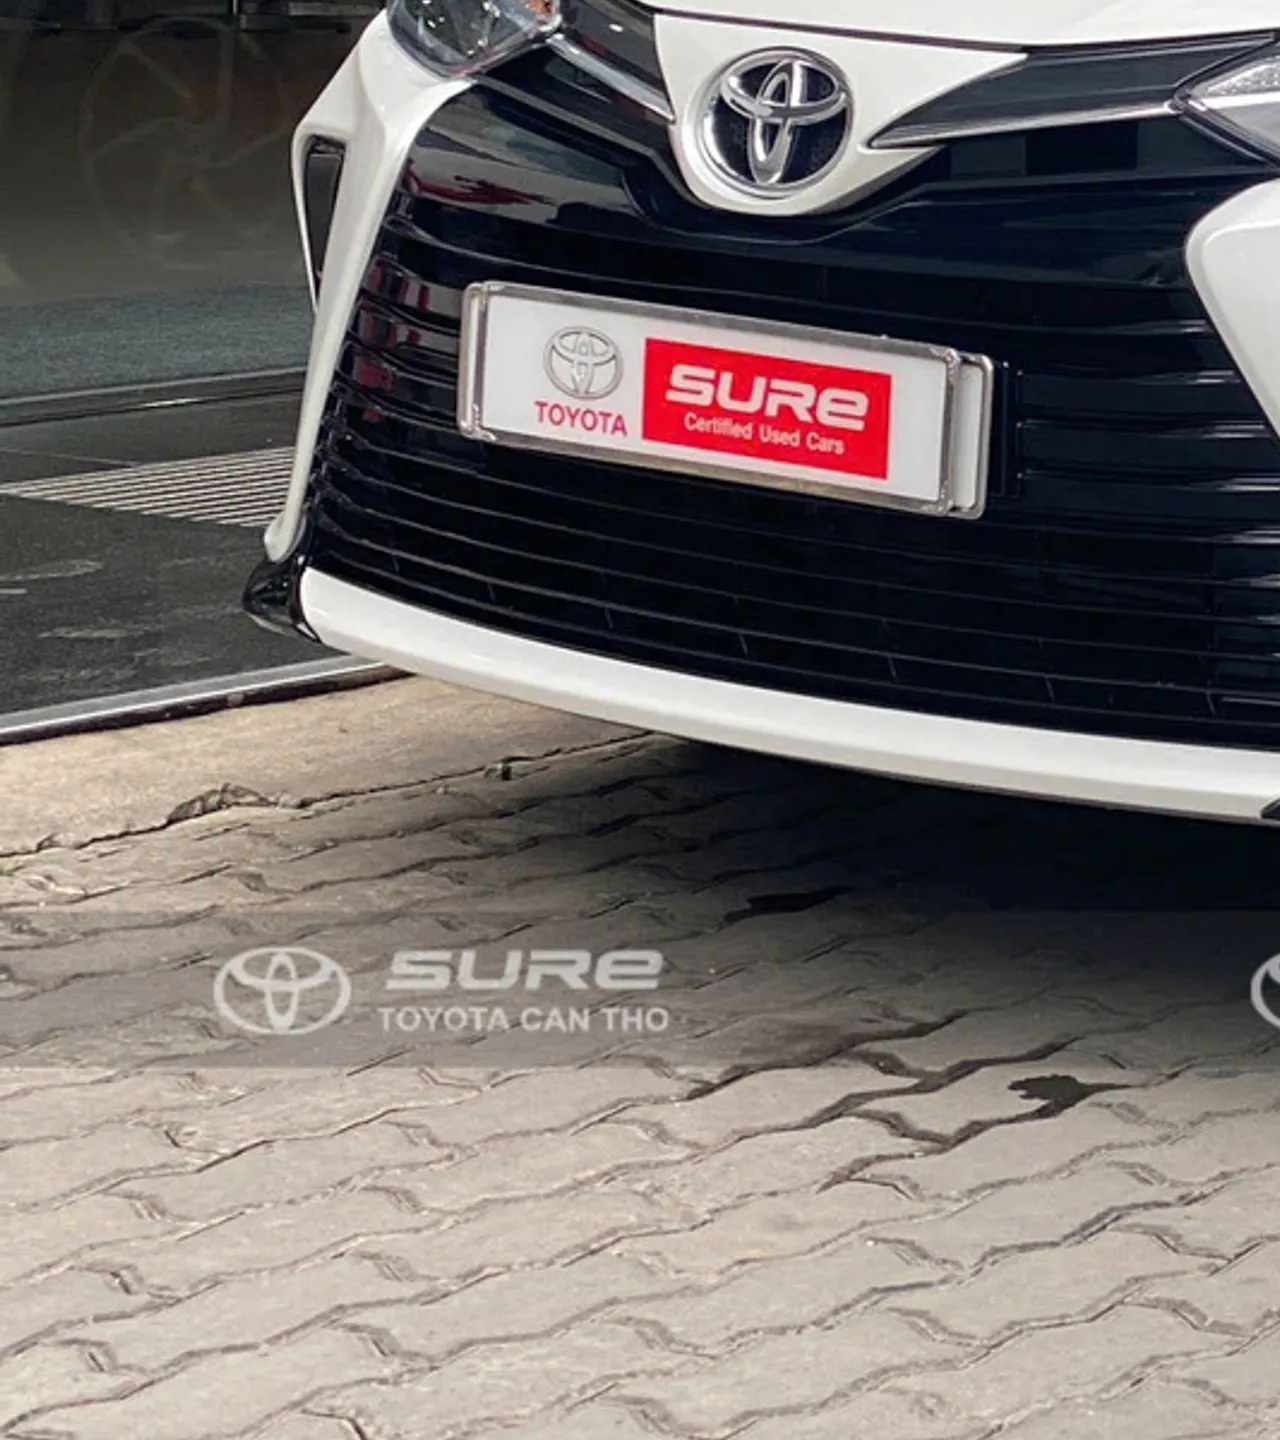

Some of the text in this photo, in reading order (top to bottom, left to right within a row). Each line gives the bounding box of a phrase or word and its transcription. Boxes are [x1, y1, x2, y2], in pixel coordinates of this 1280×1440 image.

[534, 400, 627, 437] TOYOTA
[666, 363, 869, 432] SURE
[684, 412, 846, 456] Certified Used Cars
